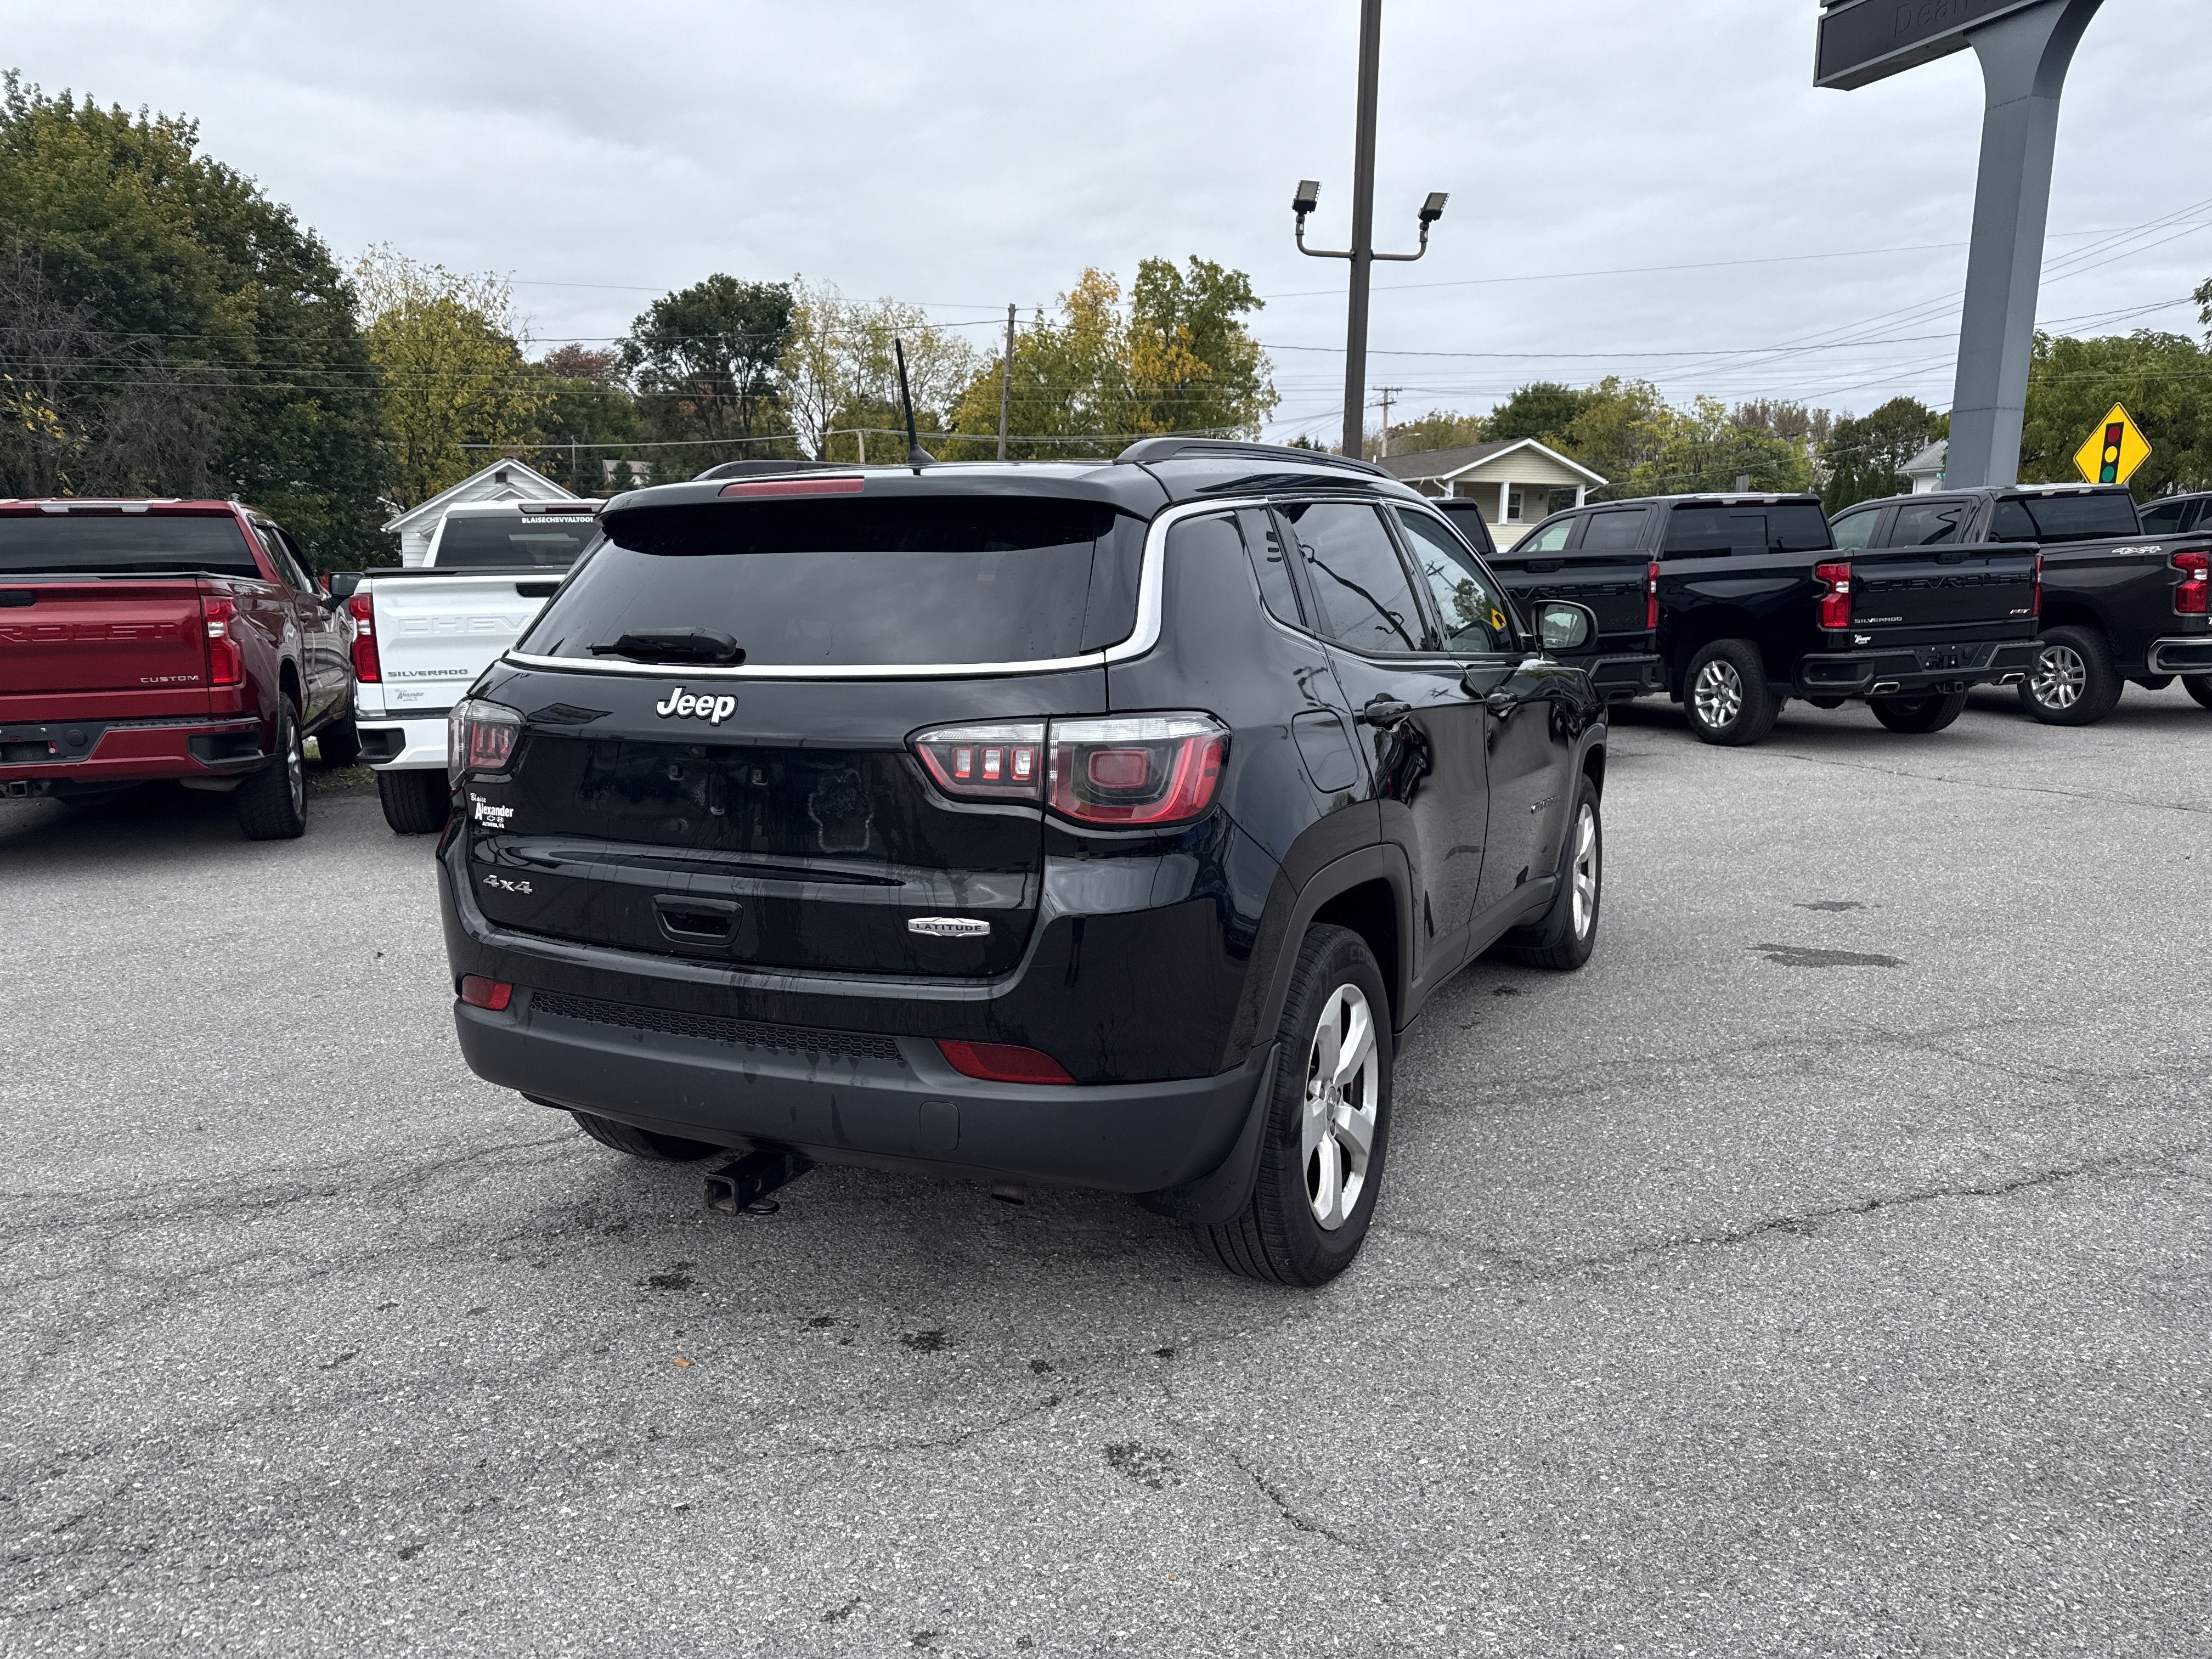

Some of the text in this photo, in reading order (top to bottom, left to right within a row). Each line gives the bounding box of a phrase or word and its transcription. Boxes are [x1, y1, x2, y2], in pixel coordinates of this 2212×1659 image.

[399, 616, 537, 634] CHEV
[657, 687, 737, 724] Jeep
[470, 793, 487, 803] Blaise
[475, 802, 514, 820] Alexander
